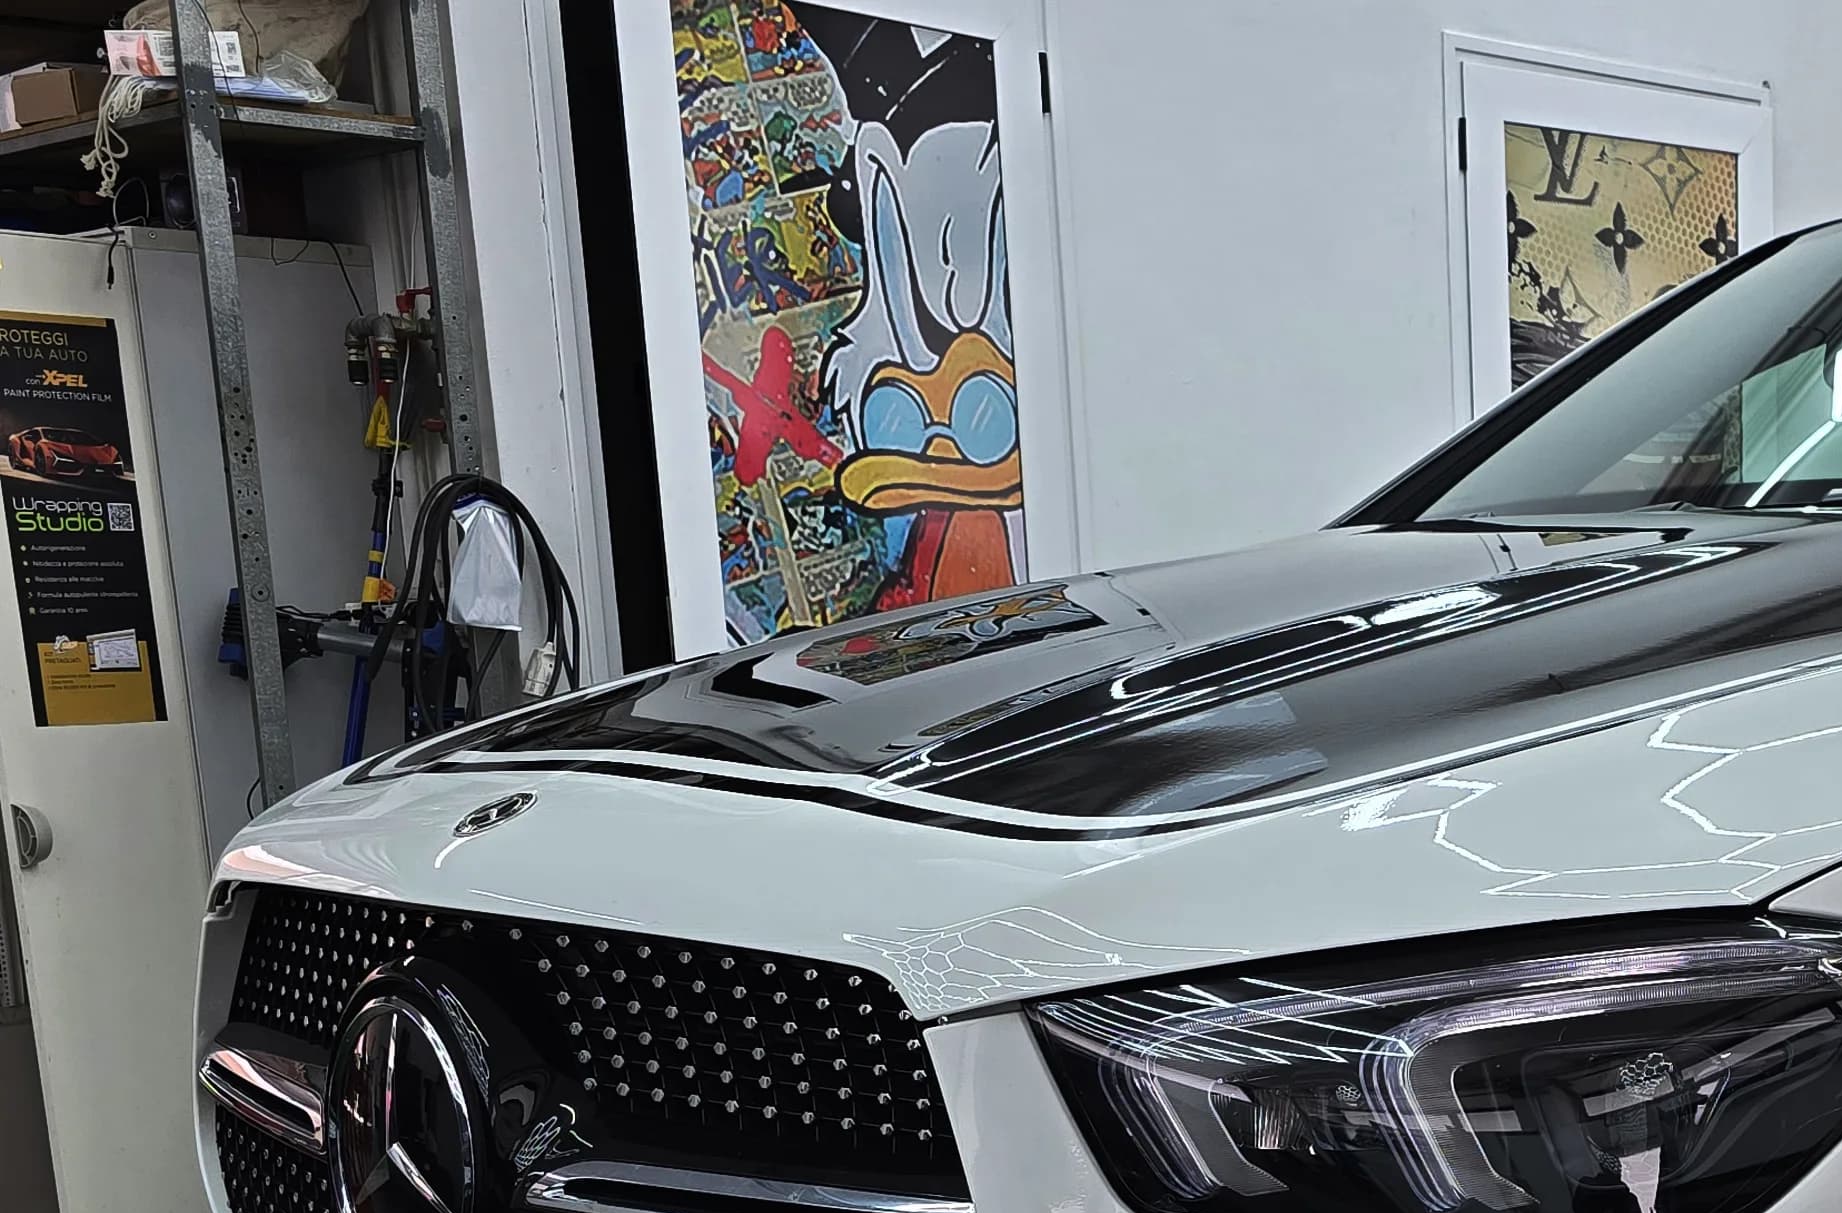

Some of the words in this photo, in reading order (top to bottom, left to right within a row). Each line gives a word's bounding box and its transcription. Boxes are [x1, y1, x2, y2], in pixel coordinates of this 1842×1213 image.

[14, 346, 44, 359] TUA
[48, 348, 88, 362] AUTO
[43, 369, 88, 388] XPEL
[3, 388, 30, 398] PAINT
[32, 389, 90, 401] PROTECTION
[91, 393, 112, 402] FILM
[12, 496, 103, 516] Wrapping
[15, 511, 104, 532] Studio
